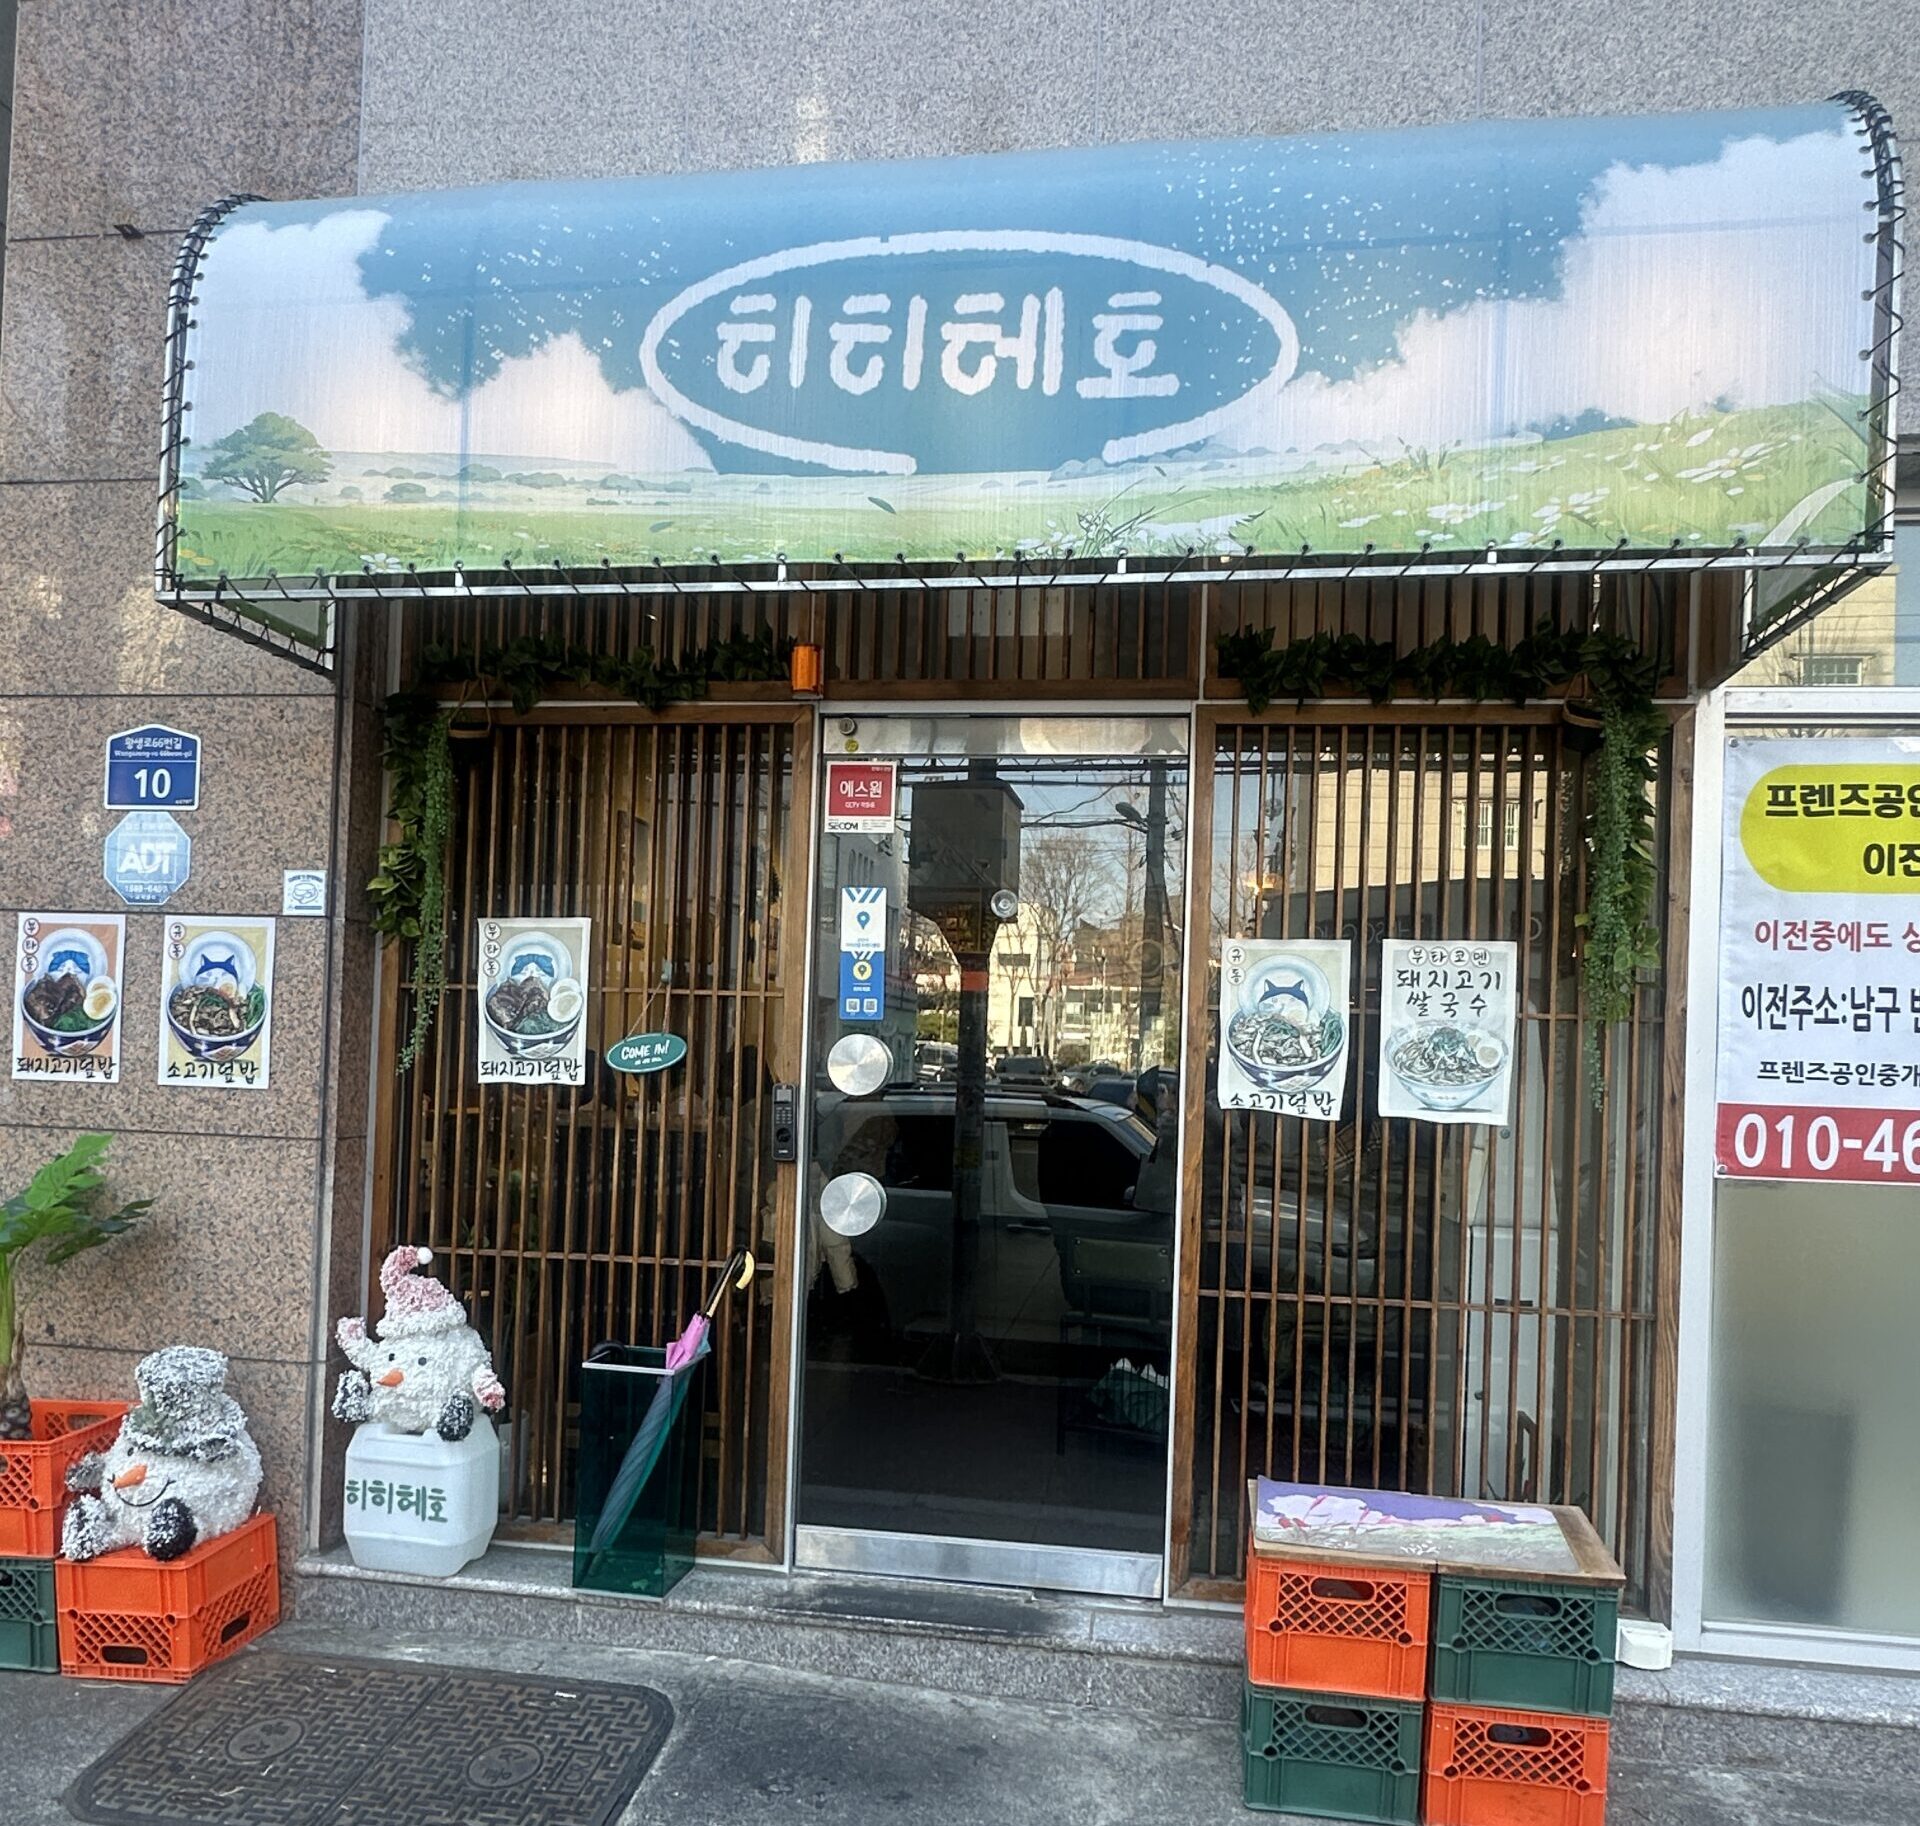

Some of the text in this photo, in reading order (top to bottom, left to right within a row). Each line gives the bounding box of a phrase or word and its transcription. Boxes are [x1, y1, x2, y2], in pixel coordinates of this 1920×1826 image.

[717, 288, 1179, 399] 히히헤호
[134, 768, 171, 799] 10
[839, 779, 883, 798] 에스원
[828, 821, 859, 831] SECOM
[117, 841, 176, 875] ADT
[24, 920, 39, 971] 부타동
[169, 924, 185, 958] 규동
[486, 924, 500, 975] 부타동
[1754, 920, 1892, 953] 이전중에도
[1229, 948, 1243, 984] 규동
[1410, 948, 1488, 966] 부타코멘
[1396, 970, 1501, 990] 돼지고기
[1406, 990, 1488, 1018] 쌀국수
[1741, 983, 1901, 1033] 이전주소:남구
[621, 1040, 670, 1060] COME IN!
[345, 1478, 449, 1523] 히히헤호
